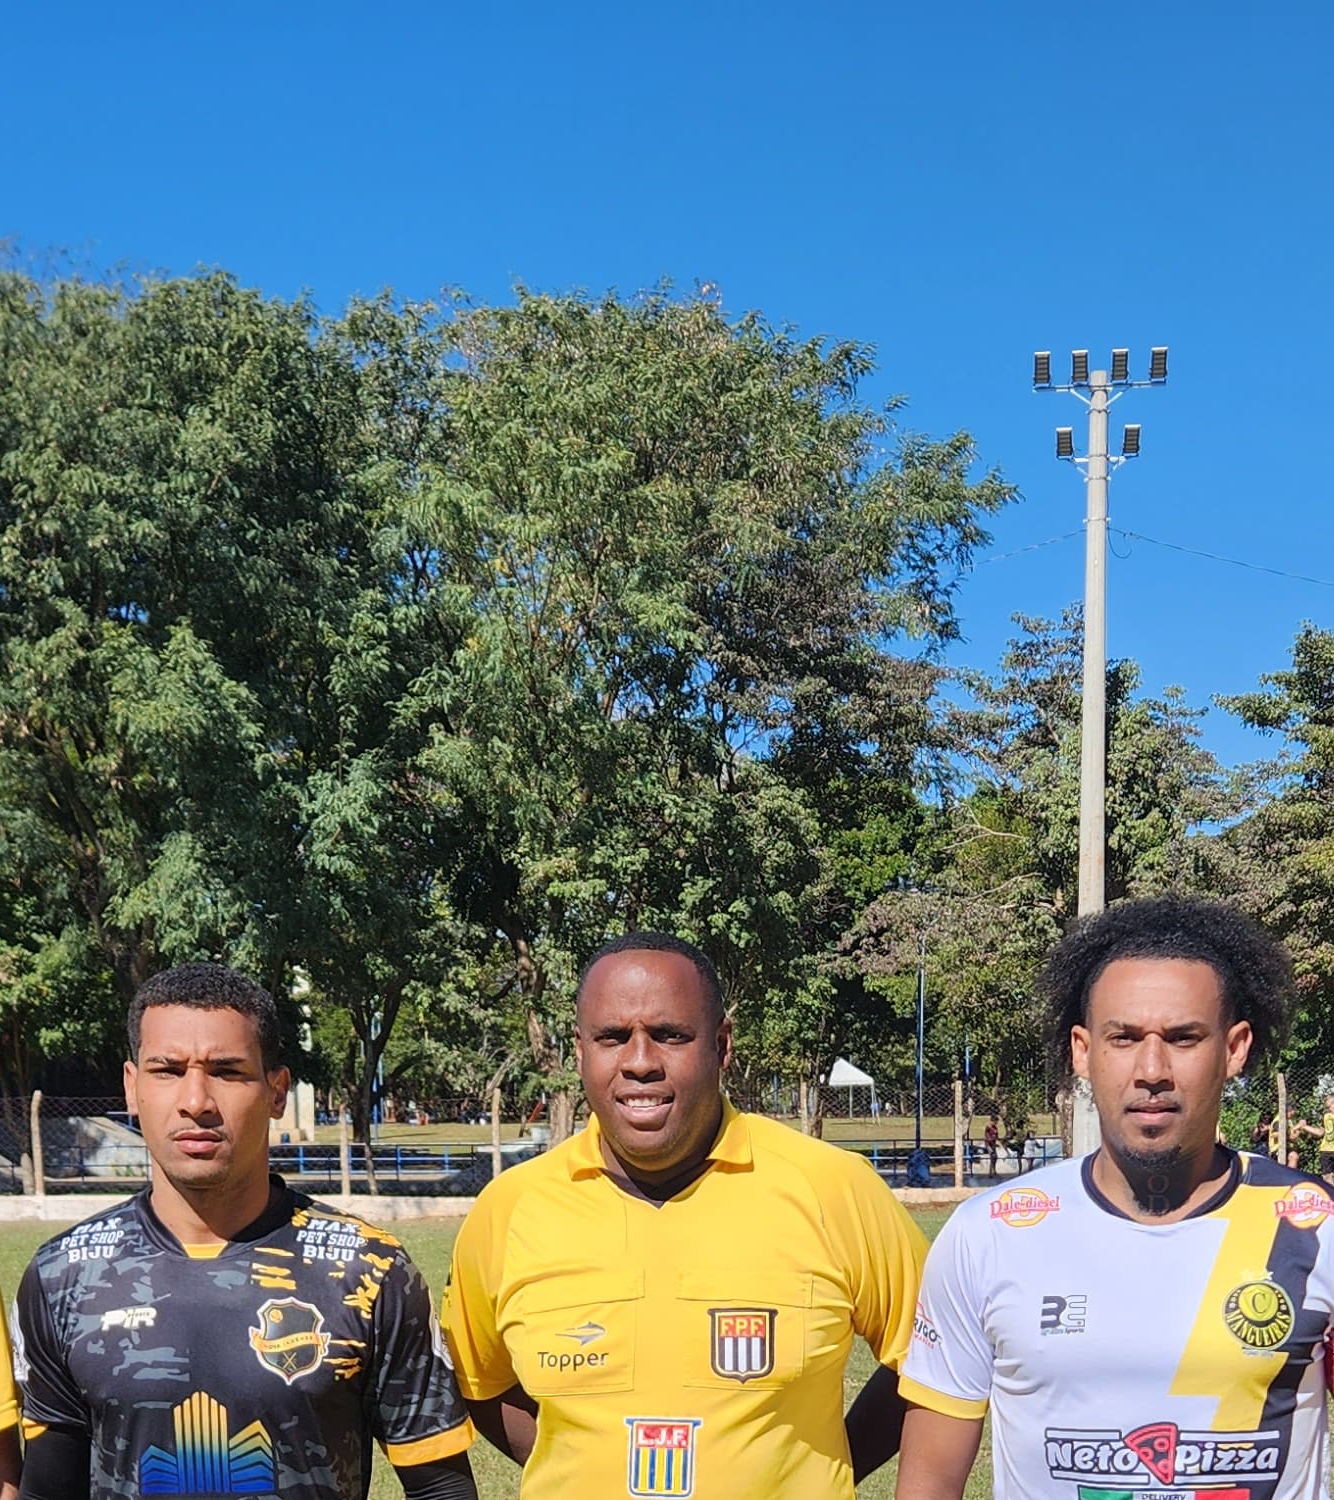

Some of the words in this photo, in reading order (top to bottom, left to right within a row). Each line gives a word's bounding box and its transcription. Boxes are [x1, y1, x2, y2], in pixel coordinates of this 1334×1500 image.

[307, 1219, 359, 1233] MAX
[60, 1235, 89, 1251] PET
[89, 1230, 125, 1244] SHOP
[296, 1230, 327, 1244] PET
[327, 1233, 366, 1248] SHOP
[68, 1245, 115, 1263] BIJU
[303, 1244, 355, 1262] BIJU
[1226, 1309, 1292, 1346] MANGUEIRAS
[537, 1351, 609, 1372] Topper
[1047, 1440, 1141, 1471] Neto
[1175, 1441, 1280, 1473] Pizza
